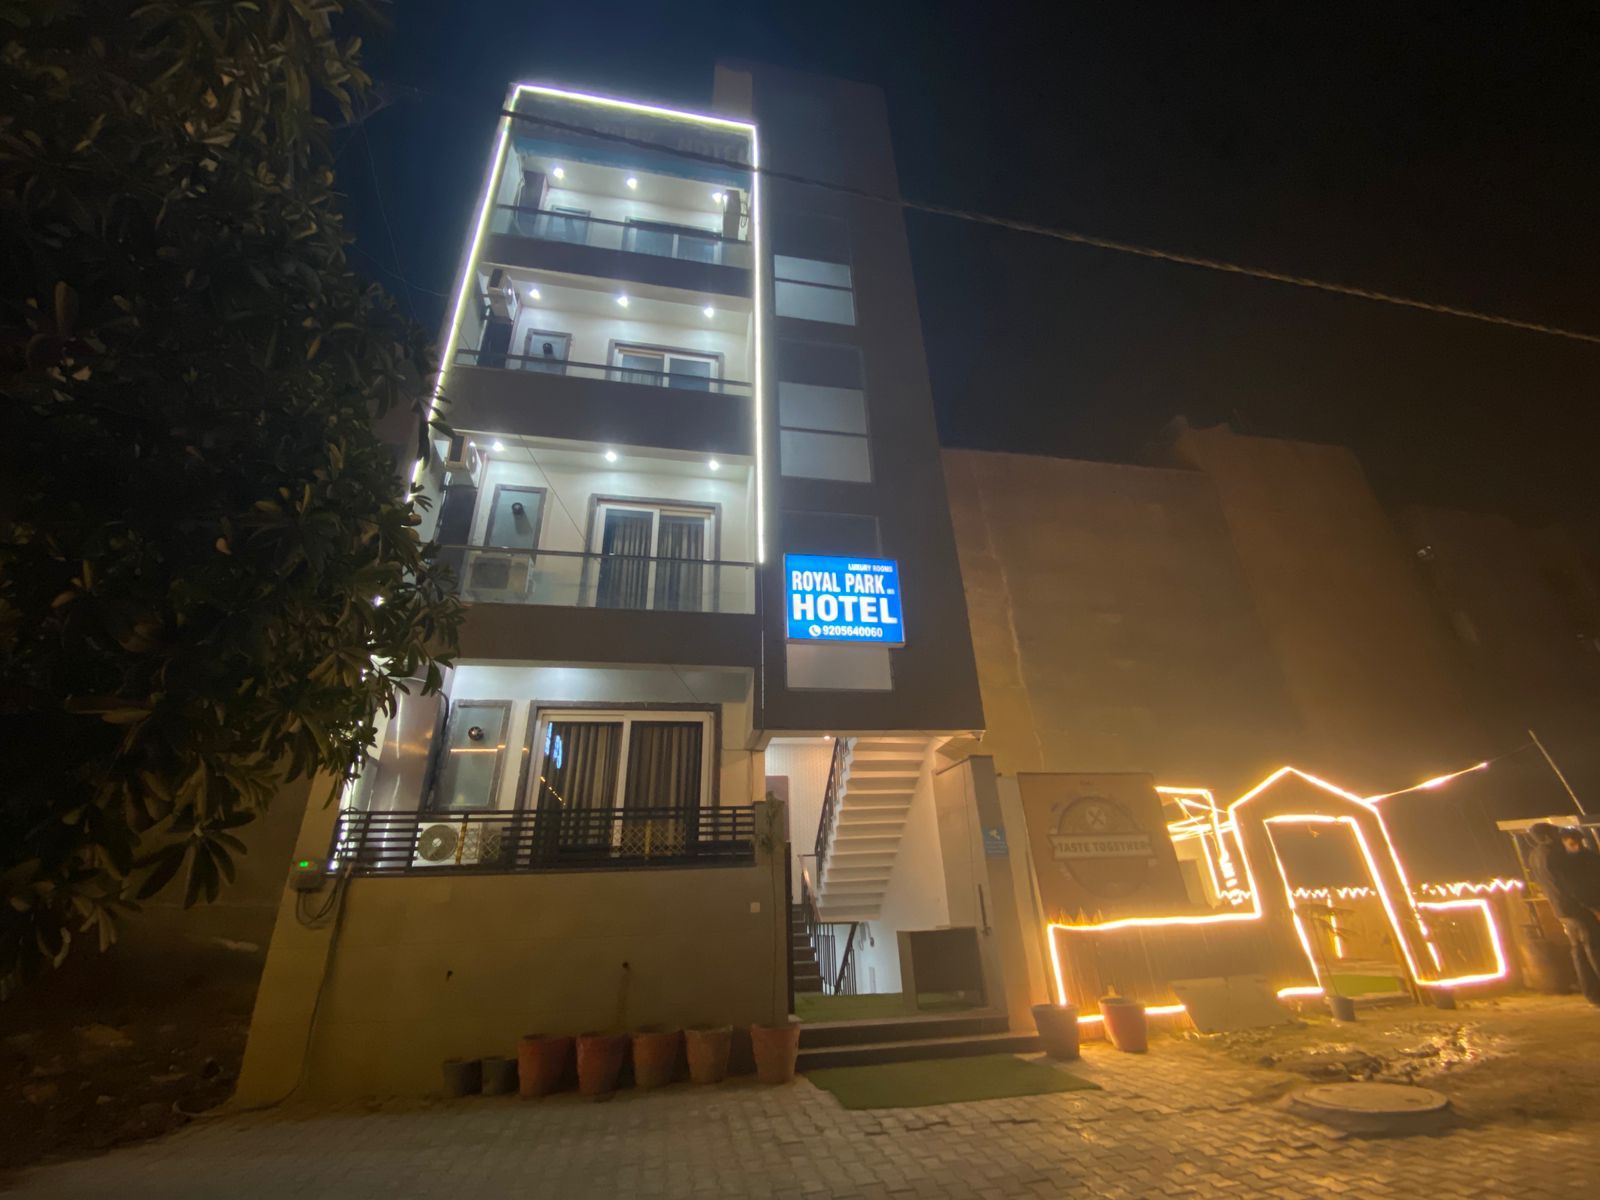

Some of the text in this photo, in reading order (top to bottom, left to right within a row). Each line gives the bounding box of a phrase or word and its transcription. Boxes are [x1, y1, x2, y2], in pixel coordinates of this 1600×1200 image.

[848, 563, 871, 571] LUXURY
[792, 570, 885, 594] ROYAL PARK
[792, 594, 898, 624] HOTEL
[822, 625, 883, 637] 9205640060
[1058, 840, 1146, 853] TASTE TOGETHER
